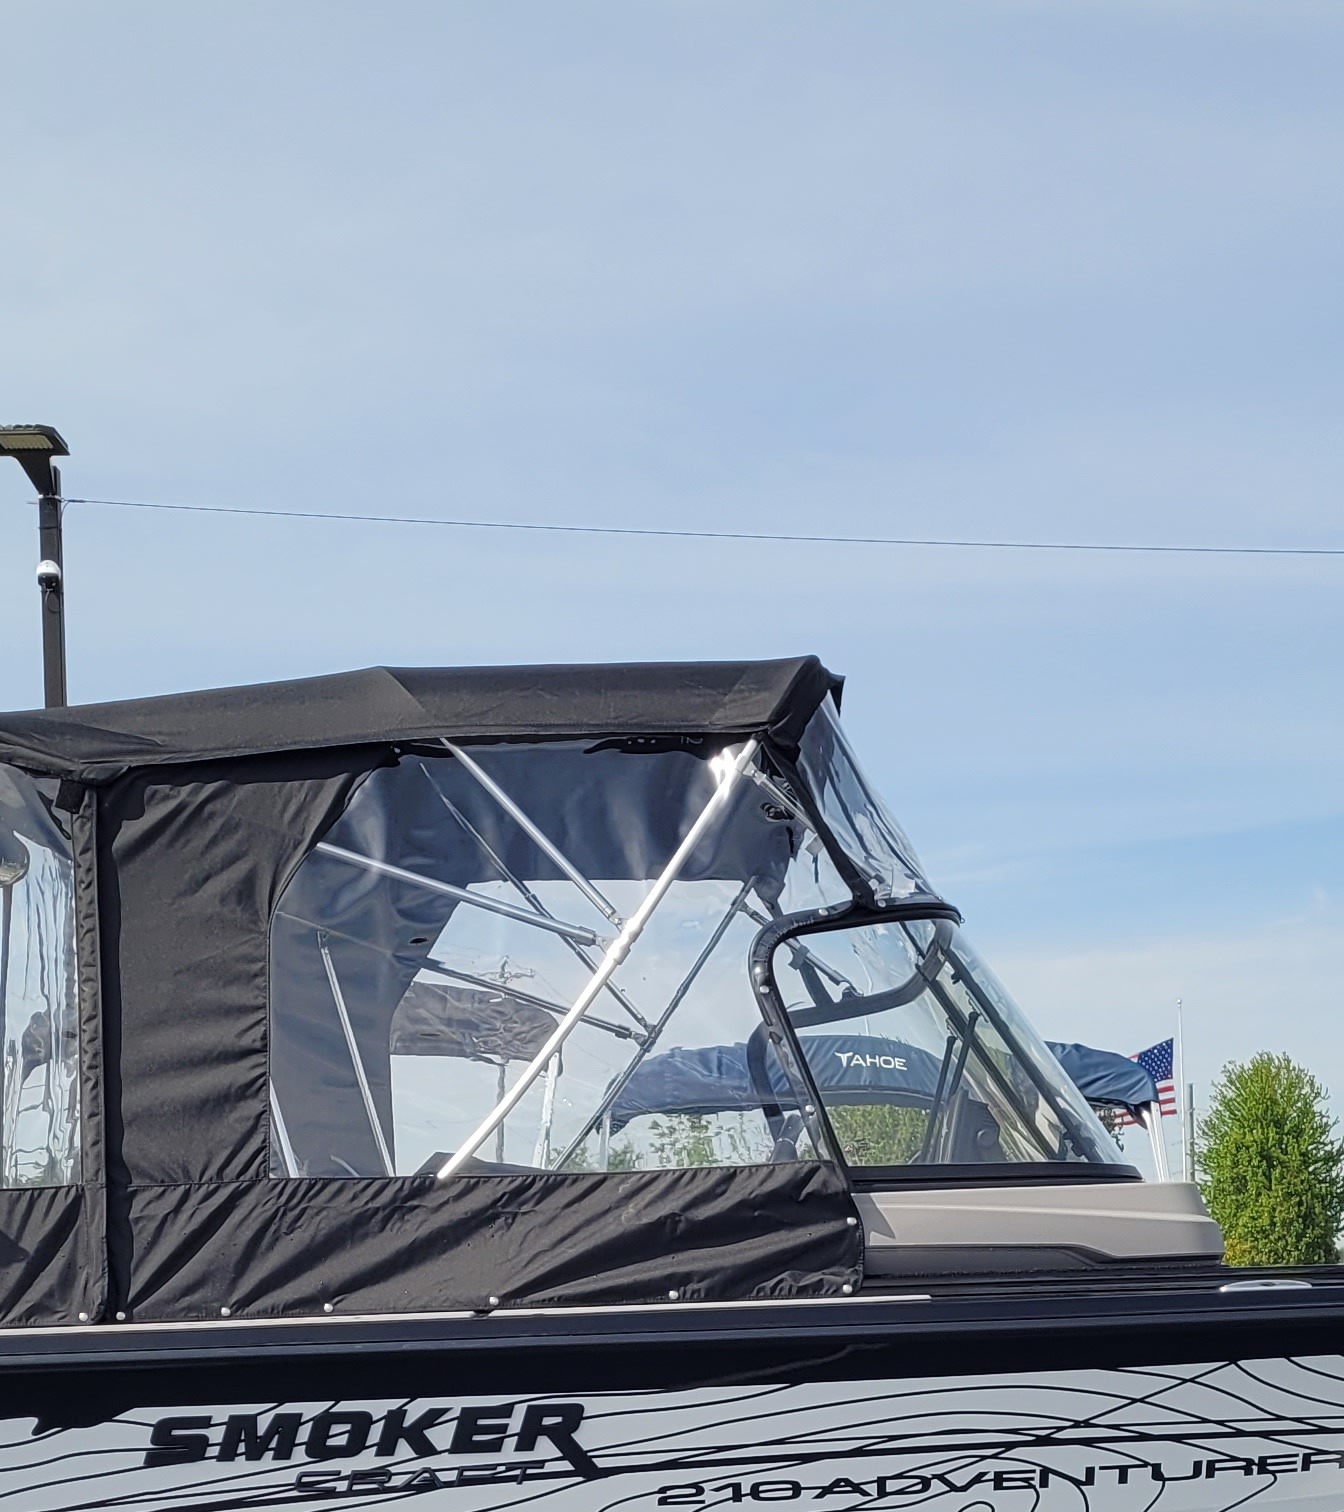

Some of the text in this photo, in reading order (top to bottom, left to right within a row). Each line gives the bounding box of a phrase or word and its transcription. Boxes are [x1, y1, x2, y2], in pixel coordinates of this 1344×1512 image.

[834, 1051, 908, 1071] TAHOE
[143, 1402, 604, 1480] SMOKER
[294, 1462, 546, 1493] CRAFT
[657, 1479, 802, 1506] 210
